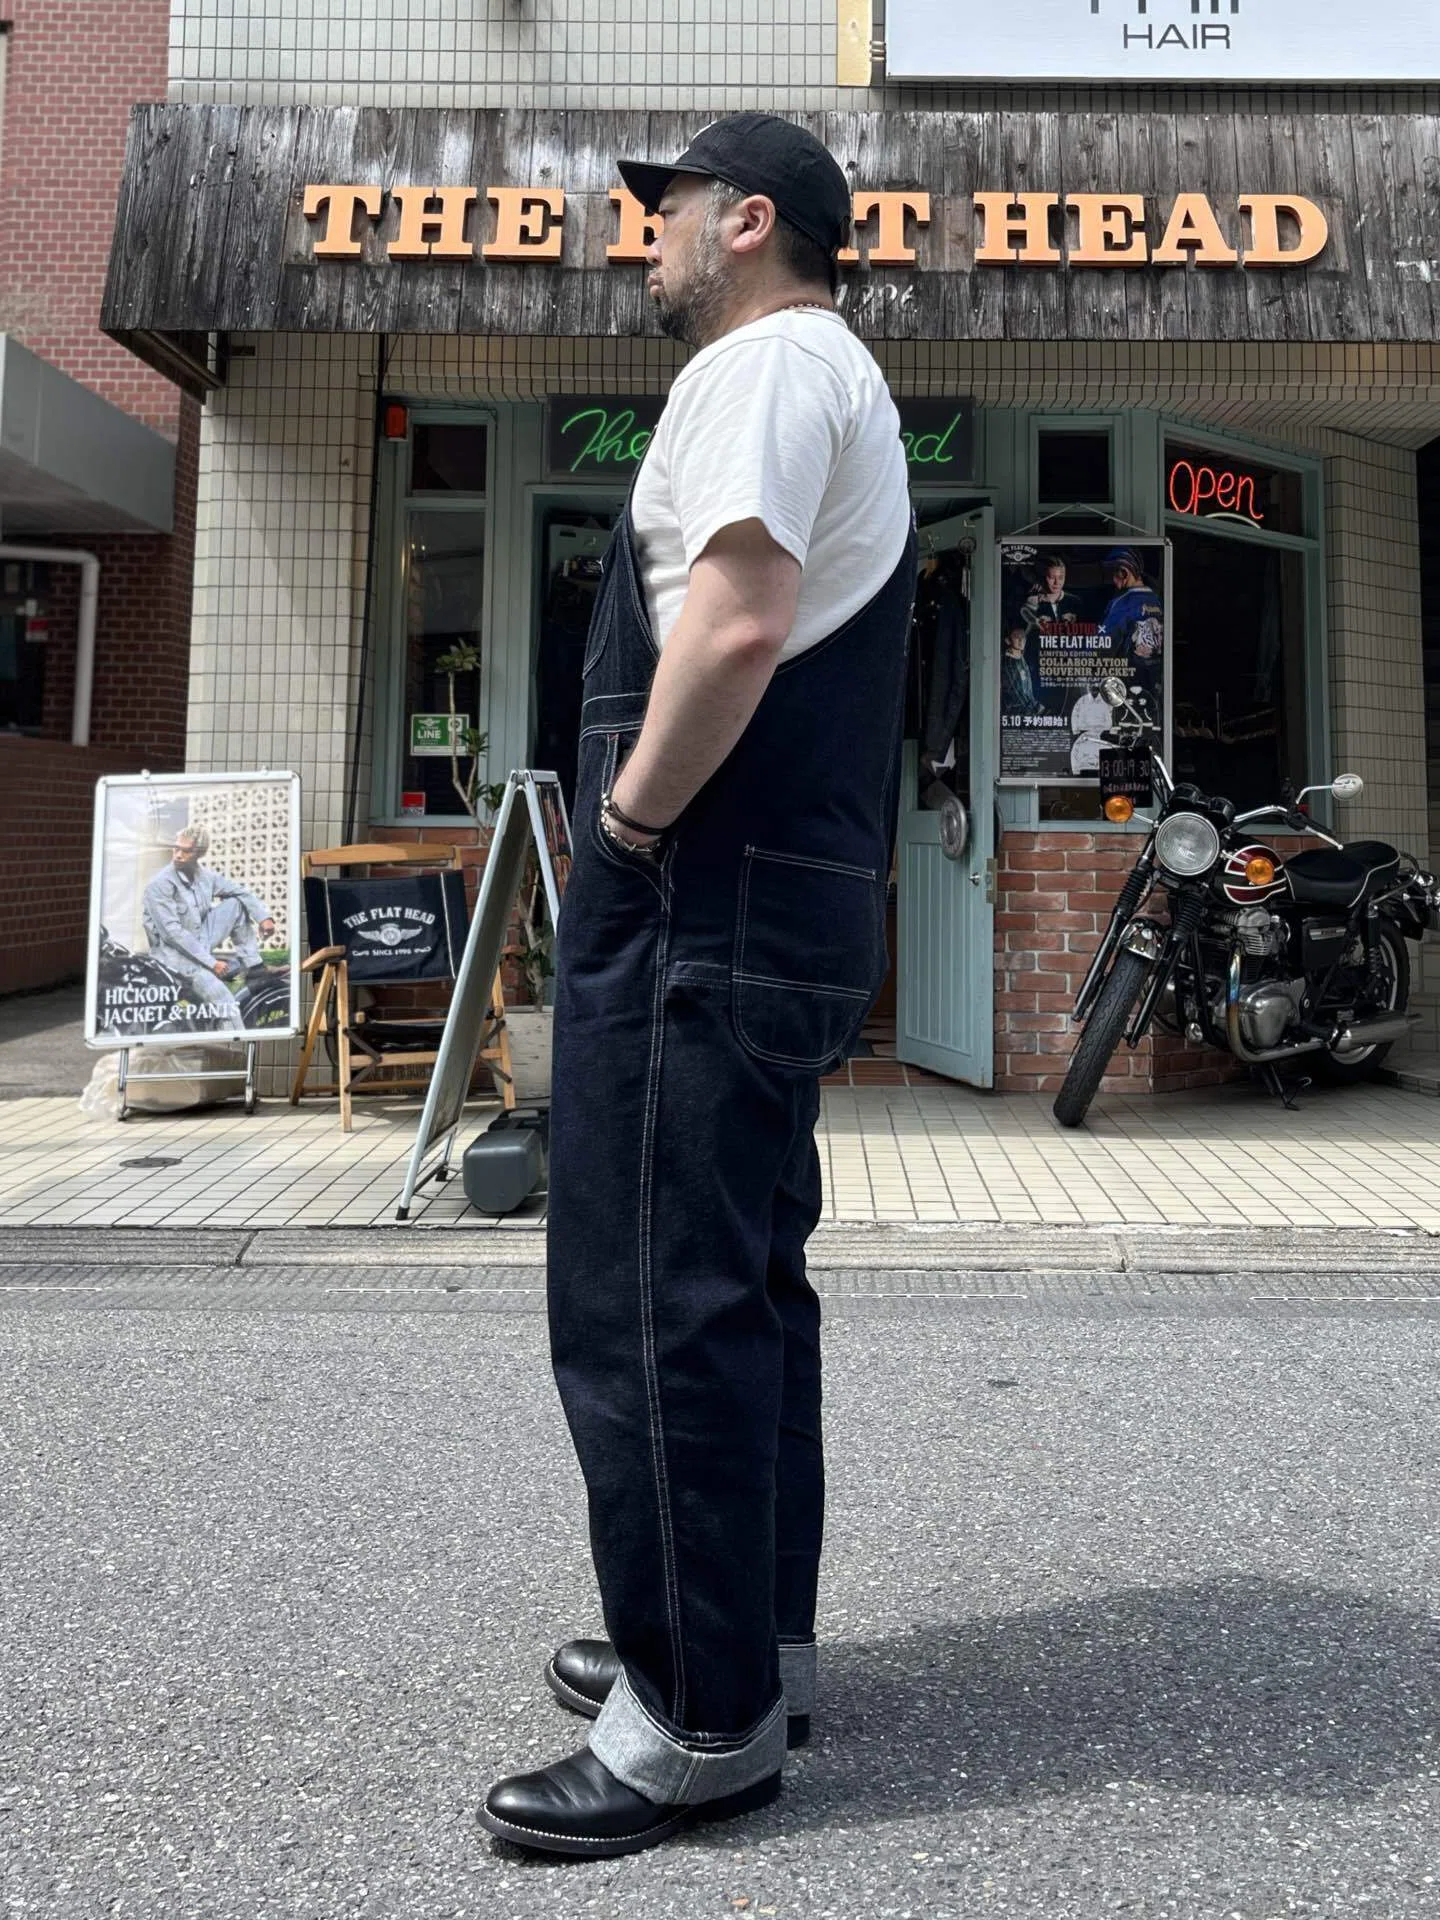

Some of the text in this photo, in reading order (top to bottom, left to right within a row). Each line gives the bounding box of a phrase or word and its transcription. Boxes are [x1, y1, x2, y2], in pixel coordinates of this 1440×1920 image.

[1123, 24, 1231, 49] HAIR
[303, 184, 565, 262] THE
[973, 191, 1328, 267] HEAD
[1169, 460, 1264, 519] Open
[1040, 636, 1112, 648] THE FLAT HEAD
[1040, 658, 1129, 667] COLLABORATION
[1040, 668, 1137, 677] SOUVENIR JACKET
[1002, 716, 1021, 727] 5.10
[417, 730, 441, 739] LINE
[343, 906, 436, 929] THE FLAT HEAD
[104, 985, 182, 1005] HICKORY
[103, 1005, 166, 1028] JACKET
[168, 1005, 183, 1021] &
[186, 1001, 240, 1020] PANTS
